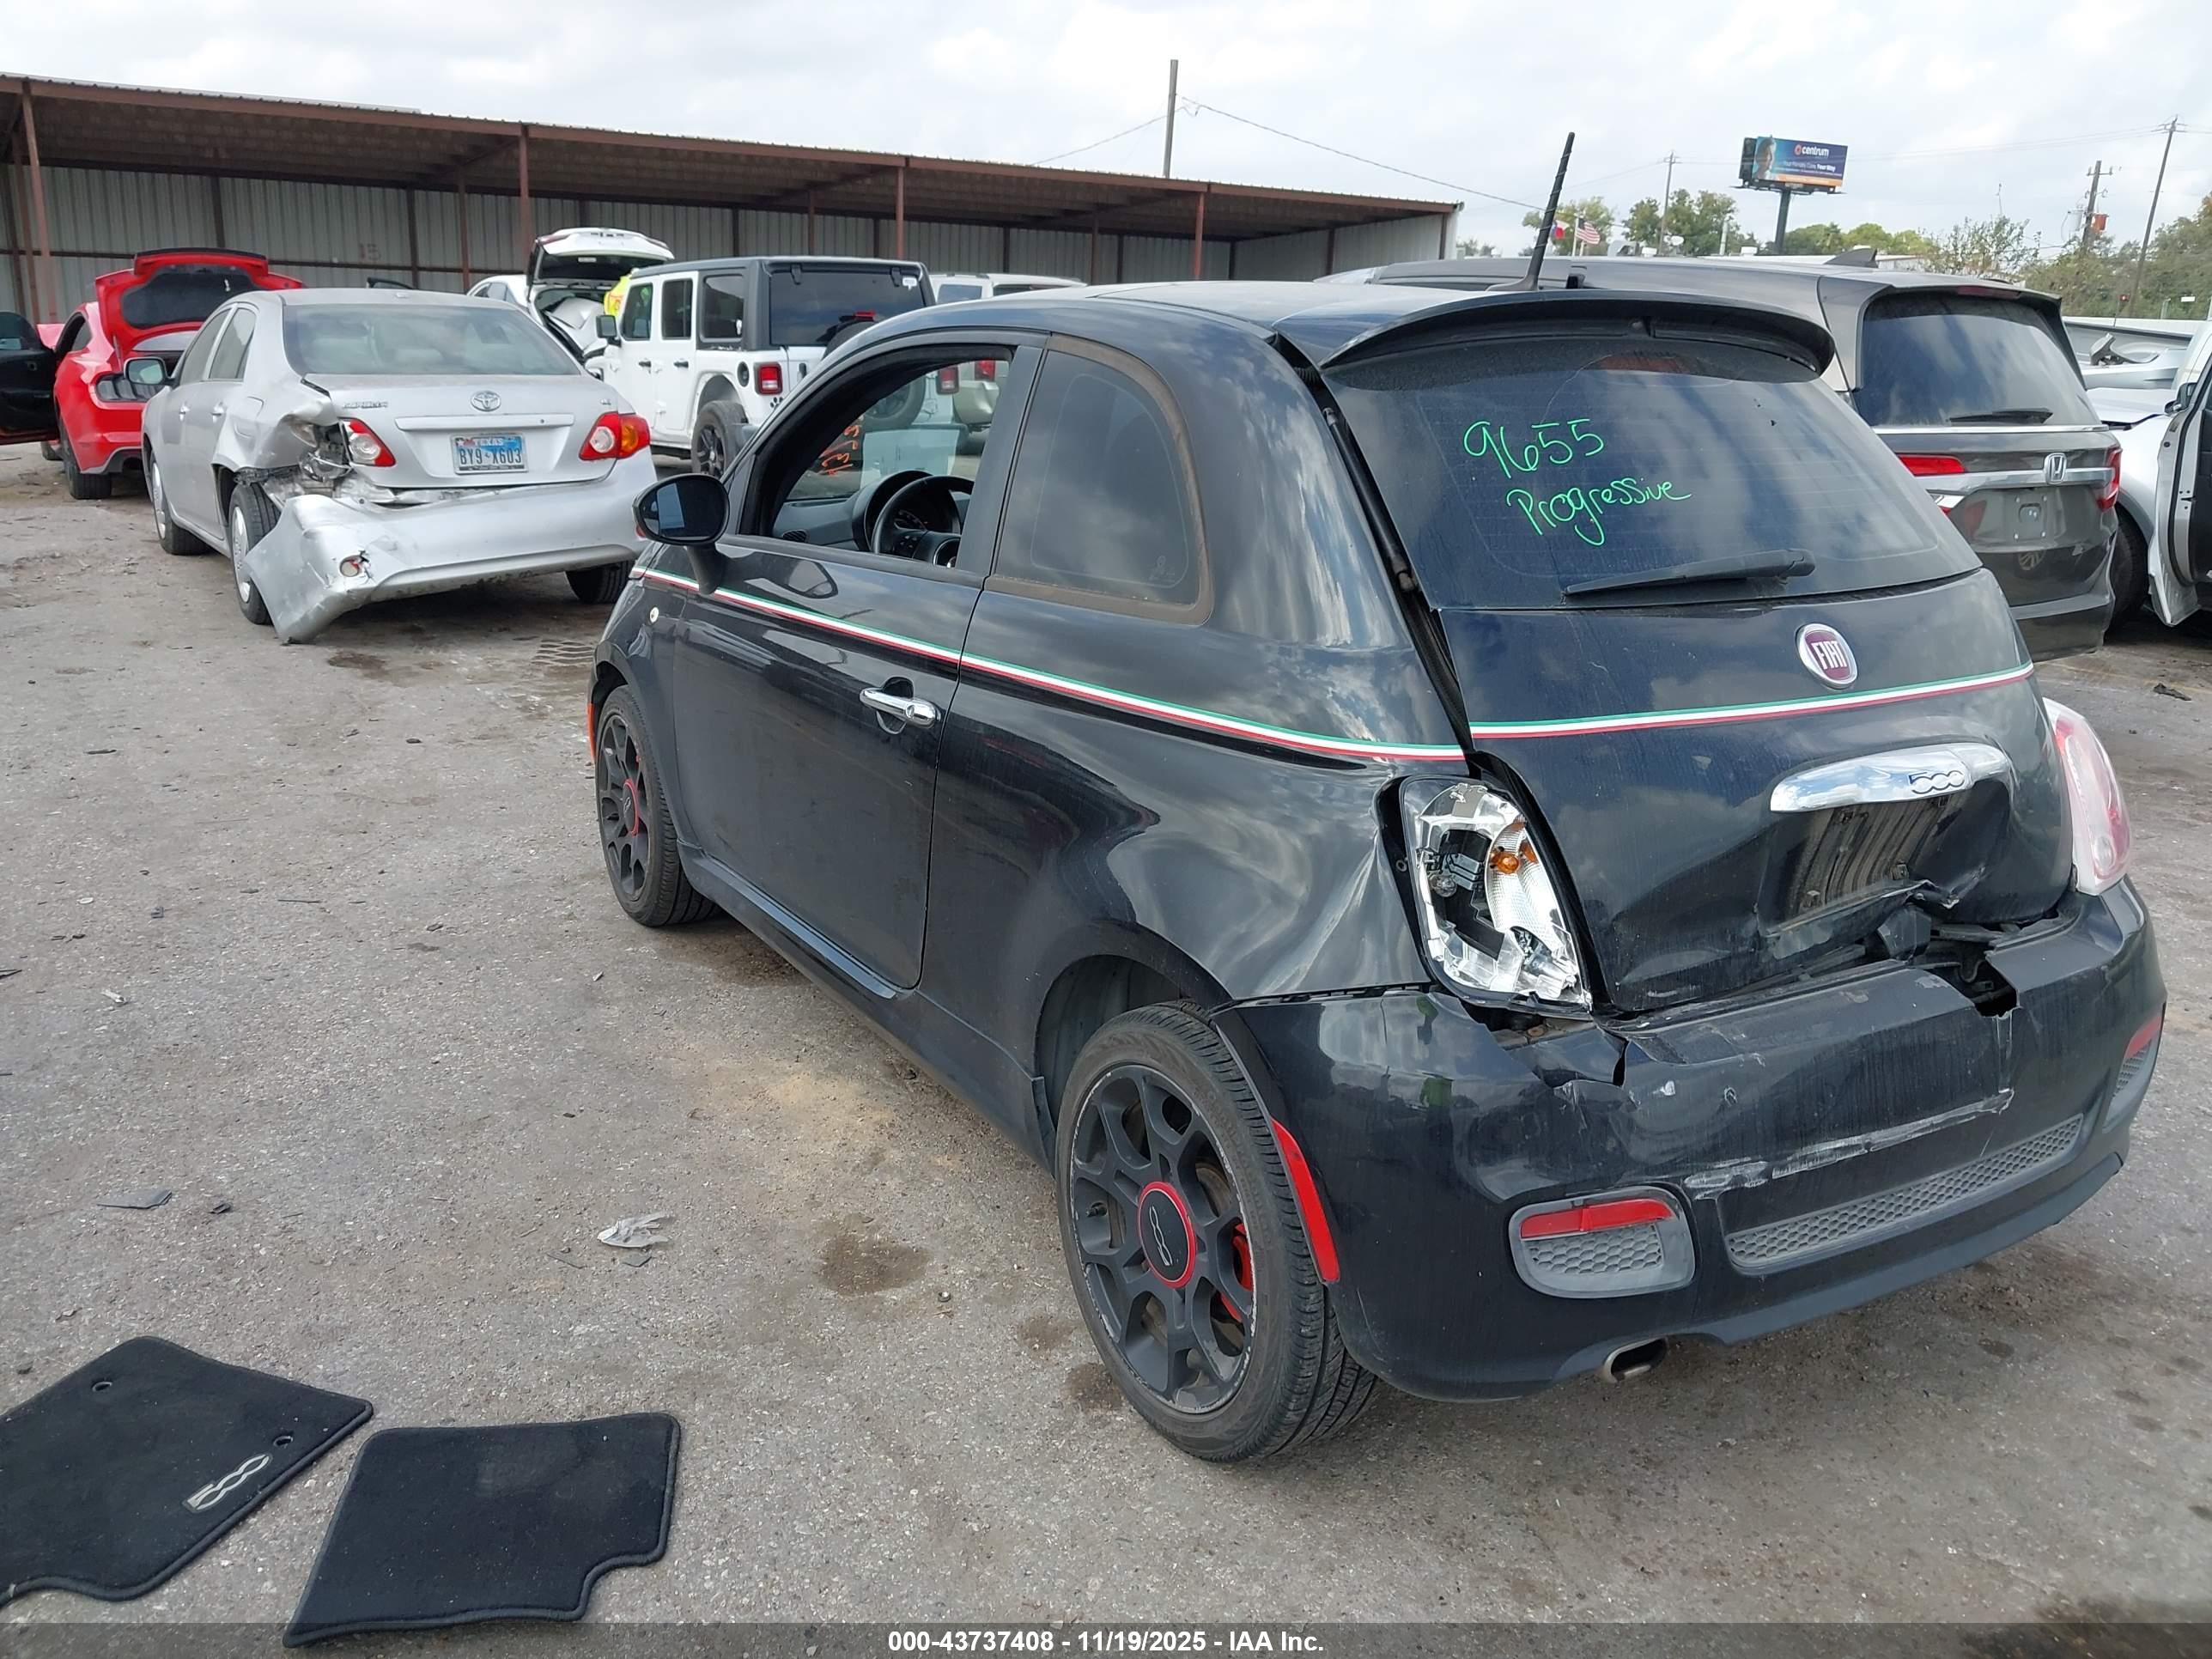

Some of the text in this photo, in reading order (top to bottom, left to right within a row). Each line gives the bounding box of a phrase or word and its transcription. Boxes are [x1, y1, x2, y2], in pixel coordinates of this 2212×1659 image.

[1802, 145, 1829, 157] centrum
[474, 437, 504, 446] TEXAS
[1463, 418, 1604, 478] 9655
[1506, 477, 1692, 546] Progressive
[1810, 640, 1848, 670] FIAT
[1908, 769, 1966, 795] 500
[186, 1454, 270, 1510] 500
